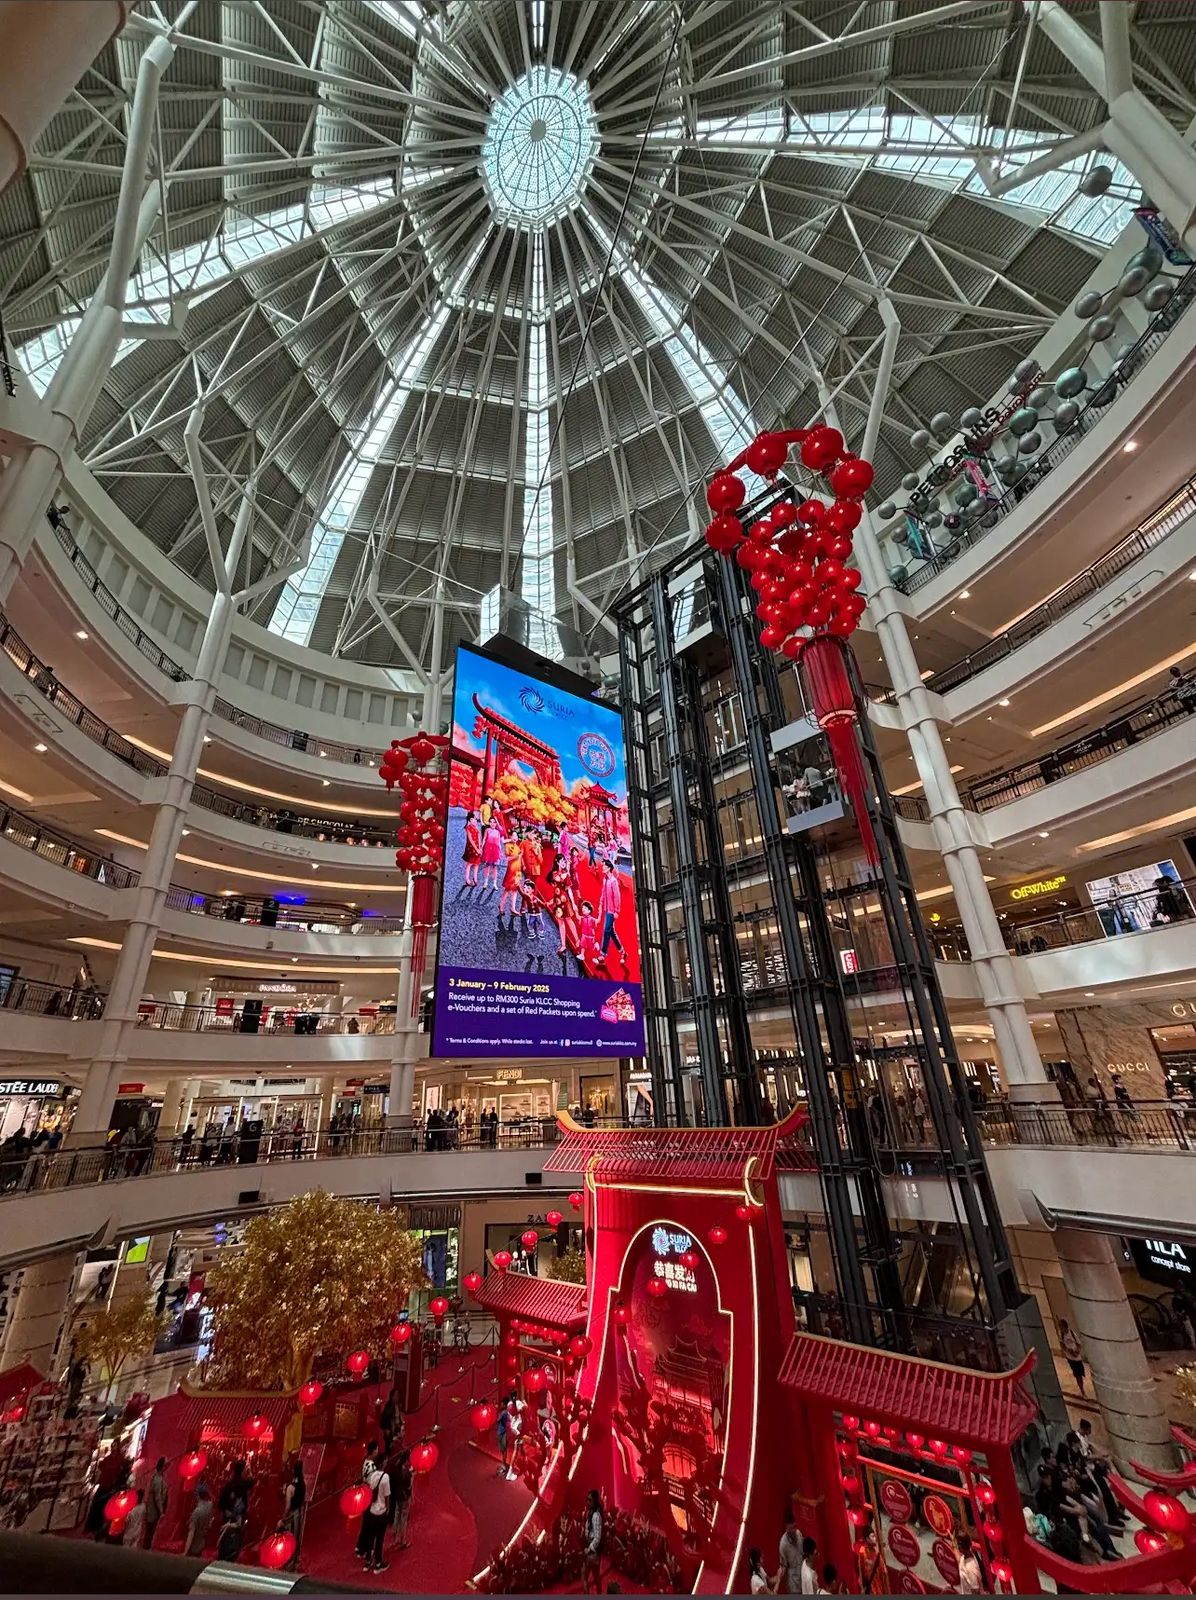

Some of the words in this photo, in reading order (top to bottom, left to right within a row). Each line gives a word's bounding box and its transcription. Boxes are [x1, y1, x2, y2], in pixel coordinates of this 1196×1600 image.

[449, 978, 455, 986] 3
[456, 979, 486, 991] January
[493, 981, 499, 989] 9
[500, 982, 532, 994] February
[532, 984, 550, 993] 2025
[448, 992, 475, 1002] Receive
[476, 995, 486, 1004] up
[487, 995, 494, 1003] to
[495, 994, 519, 1004] RM300
[519, 996, 535, 1005] Suria
[535, 997, 553, 1006] KLCC
[553, 998, 581, 1009] Shopping
[447, 1003, 486, 1013] e-Vouchers
[486, 1005, 500, 1013] and
[506, 1006, 516, 1014] set
[517, 1005, 525, 1014] of
[525, 1006, 538, 1015] Red
[538, 1007, 561, 1016] Packets
[561, 1010, 577, 1018] upon
[496, 1068, 523, 1080] FENDI
[1107, 1062, 1151, 1074] GUCCI
[249, 1122, 258, 1132] G
[669, 1233, 692, 1248] SURIA
[1150, 1255, 1174, 1270] concept
[1174, 1261, 1192, 1274] store
